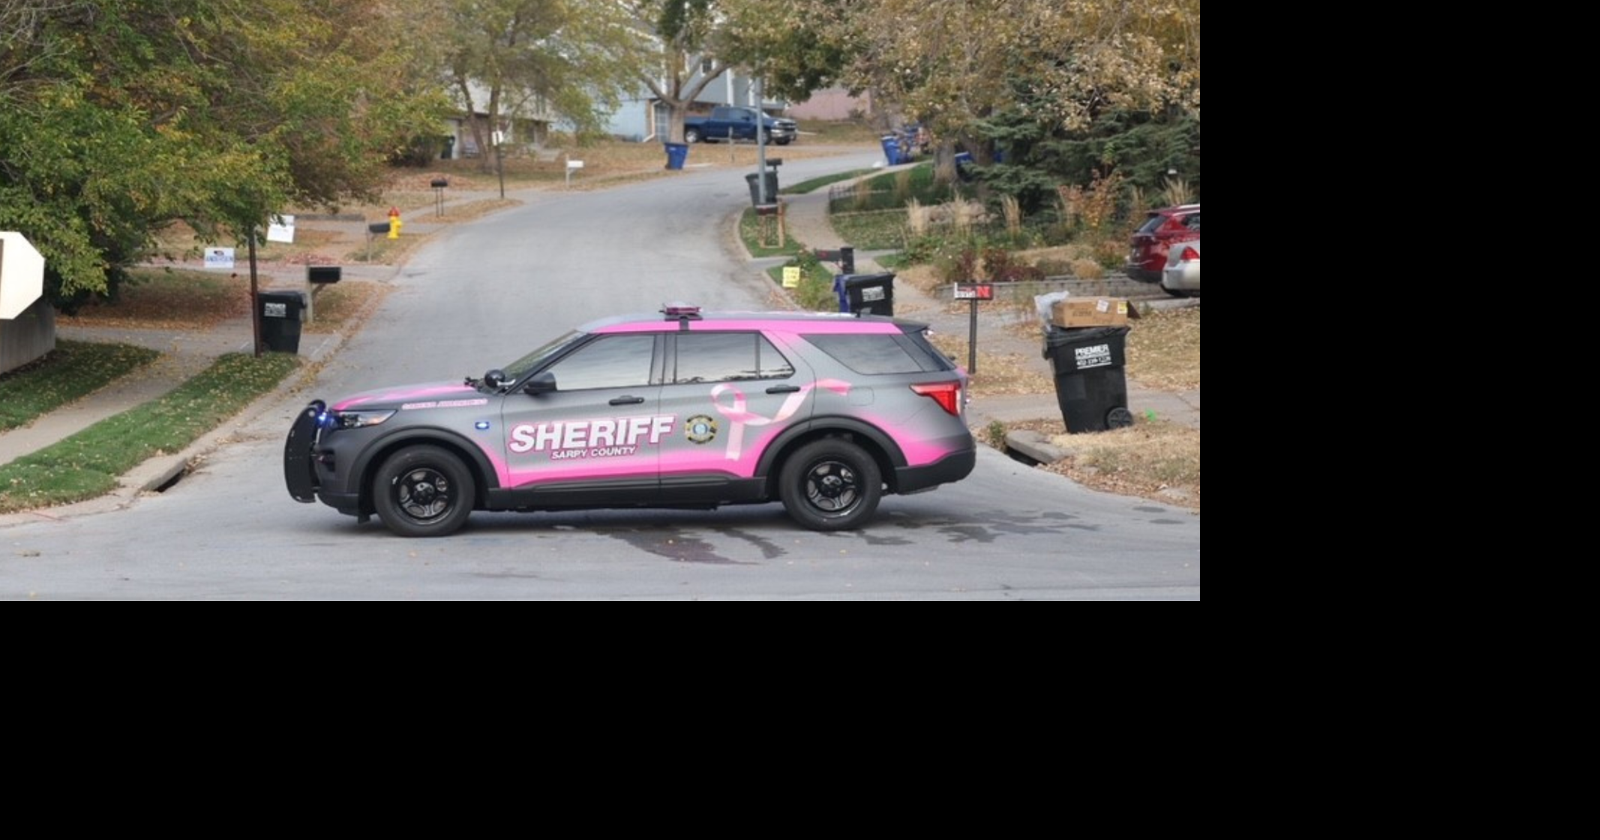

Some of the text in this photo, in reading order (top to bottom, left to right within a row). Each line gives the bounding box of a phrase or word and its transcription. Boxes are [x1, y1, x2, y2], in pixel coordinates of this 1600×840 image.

[1075, 344, 1110, 356] PREMIER
[509, 415, 675, 453] SHERIFF
[552, 446, 637, 460] SARPY COUNTY
